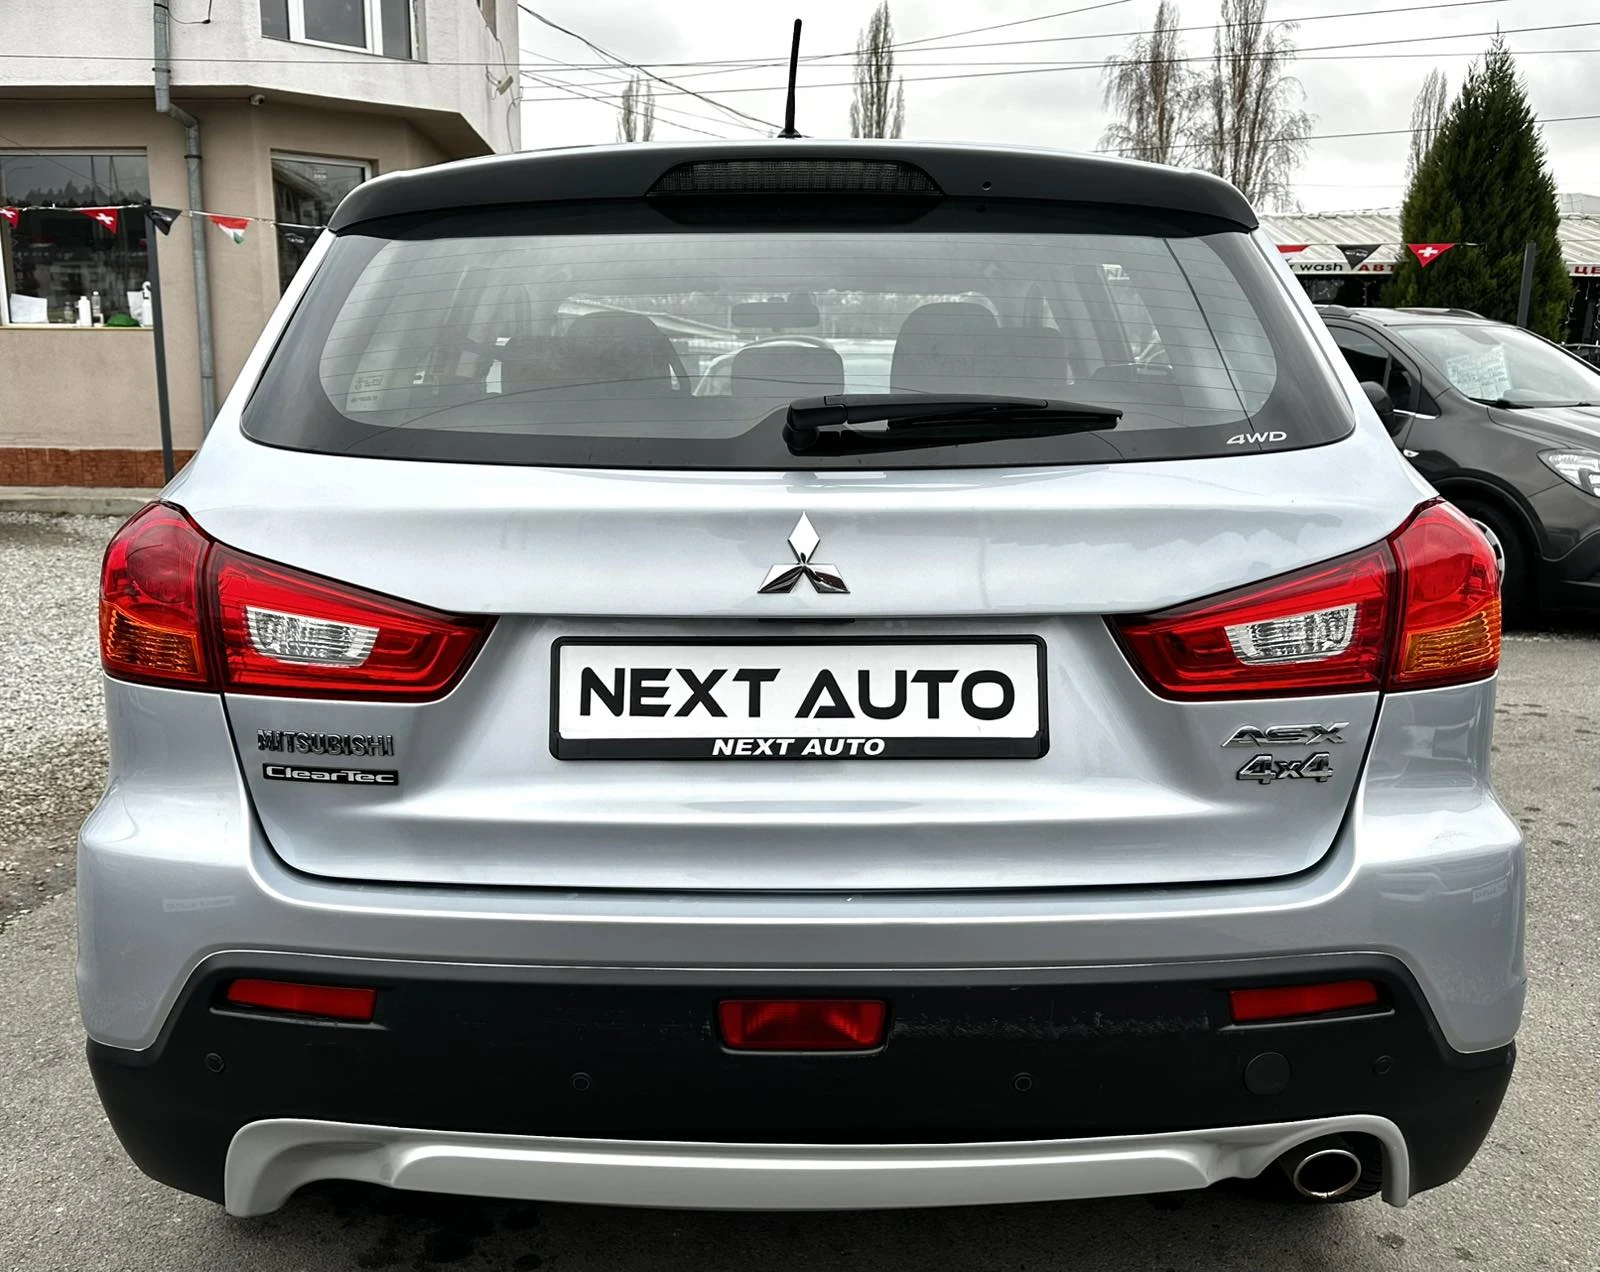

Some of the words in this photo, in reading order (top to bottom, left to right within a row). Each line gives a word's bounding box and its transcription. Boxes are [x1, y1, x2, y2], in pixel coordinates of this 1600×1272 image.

[1299, 262, 1344, 272] wash
[1226, 431, 1288, 445] 4WD
[580, 667, 781, 718] NEXT
[795, 669, 1015, 720] AUTO
[257, 729, 396, 756] MITSUBISHI
[1220, 722, 1350, 748] ASX
[712, 738, 796, 756] NEXT
[801, 738, 886, 756] AUTO
[265, 766, 395, 784] ClearTec
[1236, 751, 1335, 785] 4x4
